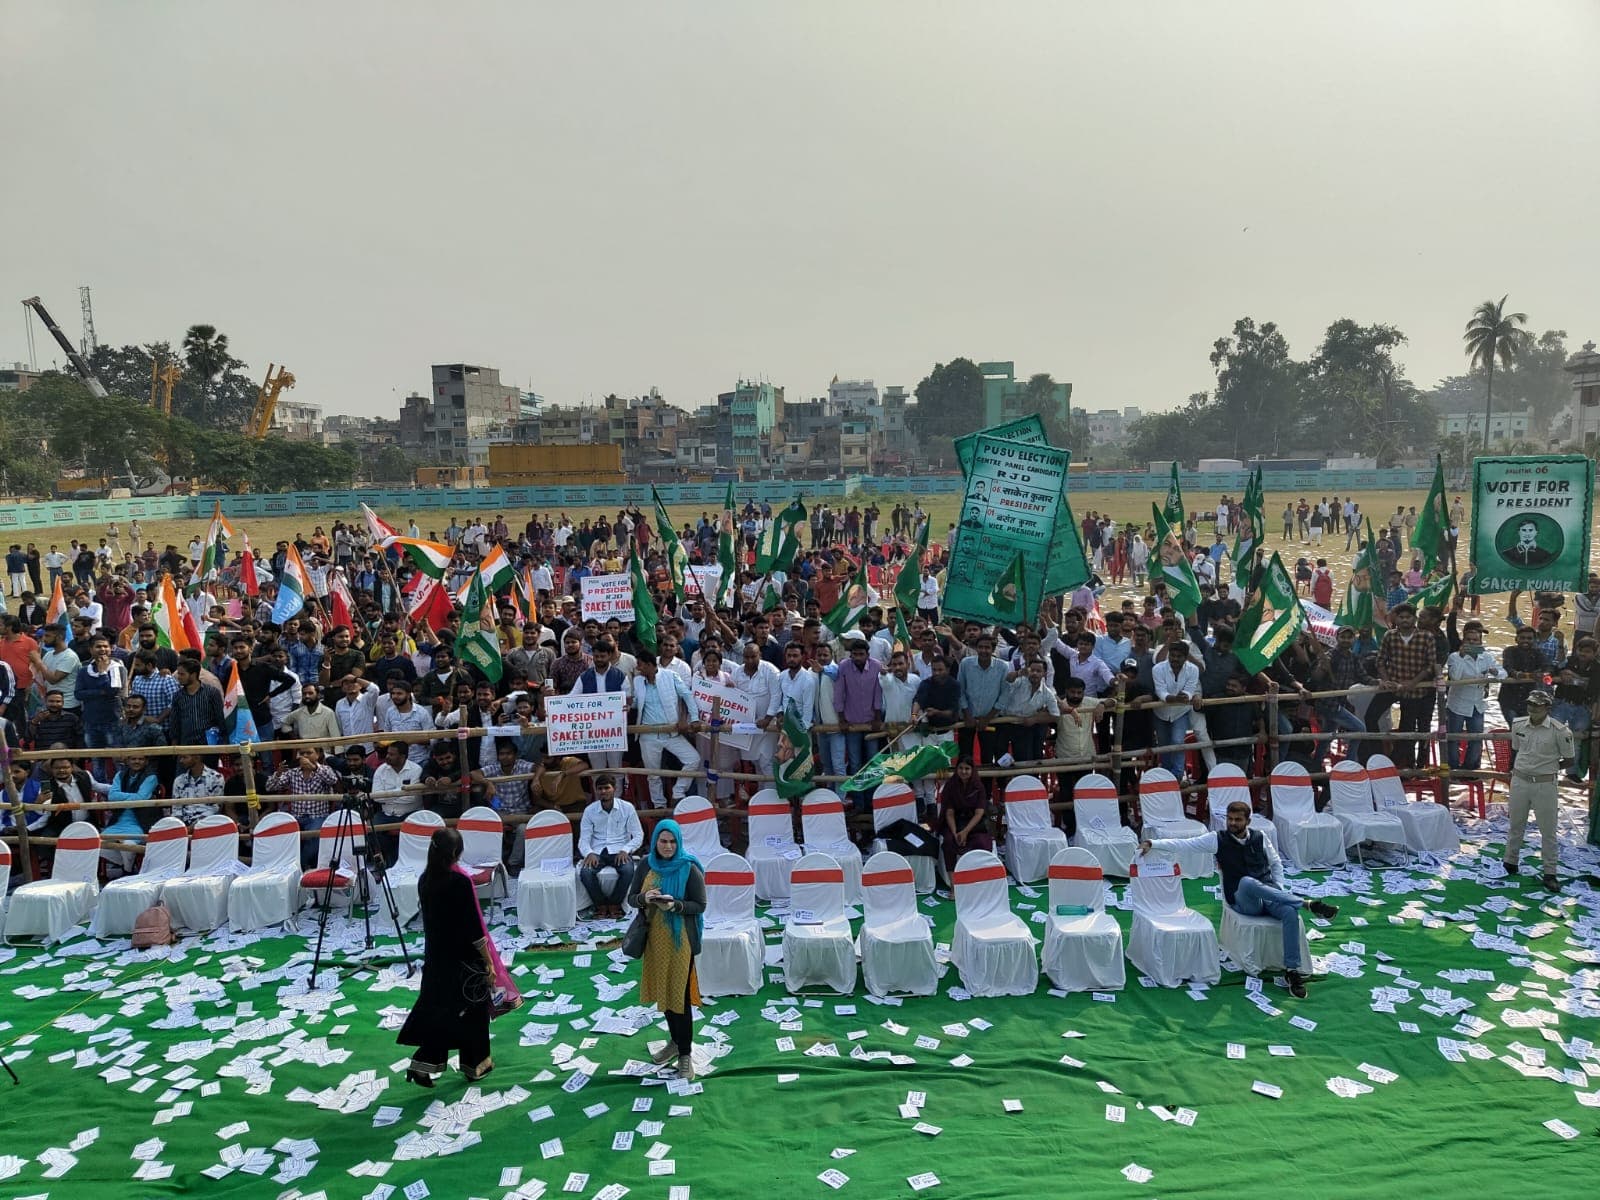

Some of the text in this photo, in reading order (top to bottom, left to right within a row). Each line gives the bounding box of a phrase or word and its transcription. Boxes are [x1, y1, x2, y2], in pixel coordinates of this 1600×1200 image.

[984, 445, 1063, 466] PUSU ELECTION
[976, 457, 1001, 467] CENTRE
[1027, 466, 1062, 478] CANDIDATE
[1536, 465, 1549, 474] 06
[997, 470, 1031, 482] RJD
[1486, 481, 1570, 494] VOTE FOR
[1003, 487, 1054, 503] साकेत कुमार
[1000, 498, 1047, 512] PRESIDENT
[1497, 498, 1573, 507] PRESIDENT
[989, 522, 1045, 538] VICE PRESIDENT
[588, 586, 631, 595] PRESIDEN
[1480, 577, 1573, 591] SAKET KUMAR
[585, 600, 632, 612] SAKET KUM
[694, 690, 748, 714] PREIDENT
[552, 711, 615, 724] PRESIDENT
[571, 722, 593, 730] RJD
[552, 727, 623, 742] SAKET KUMAR
